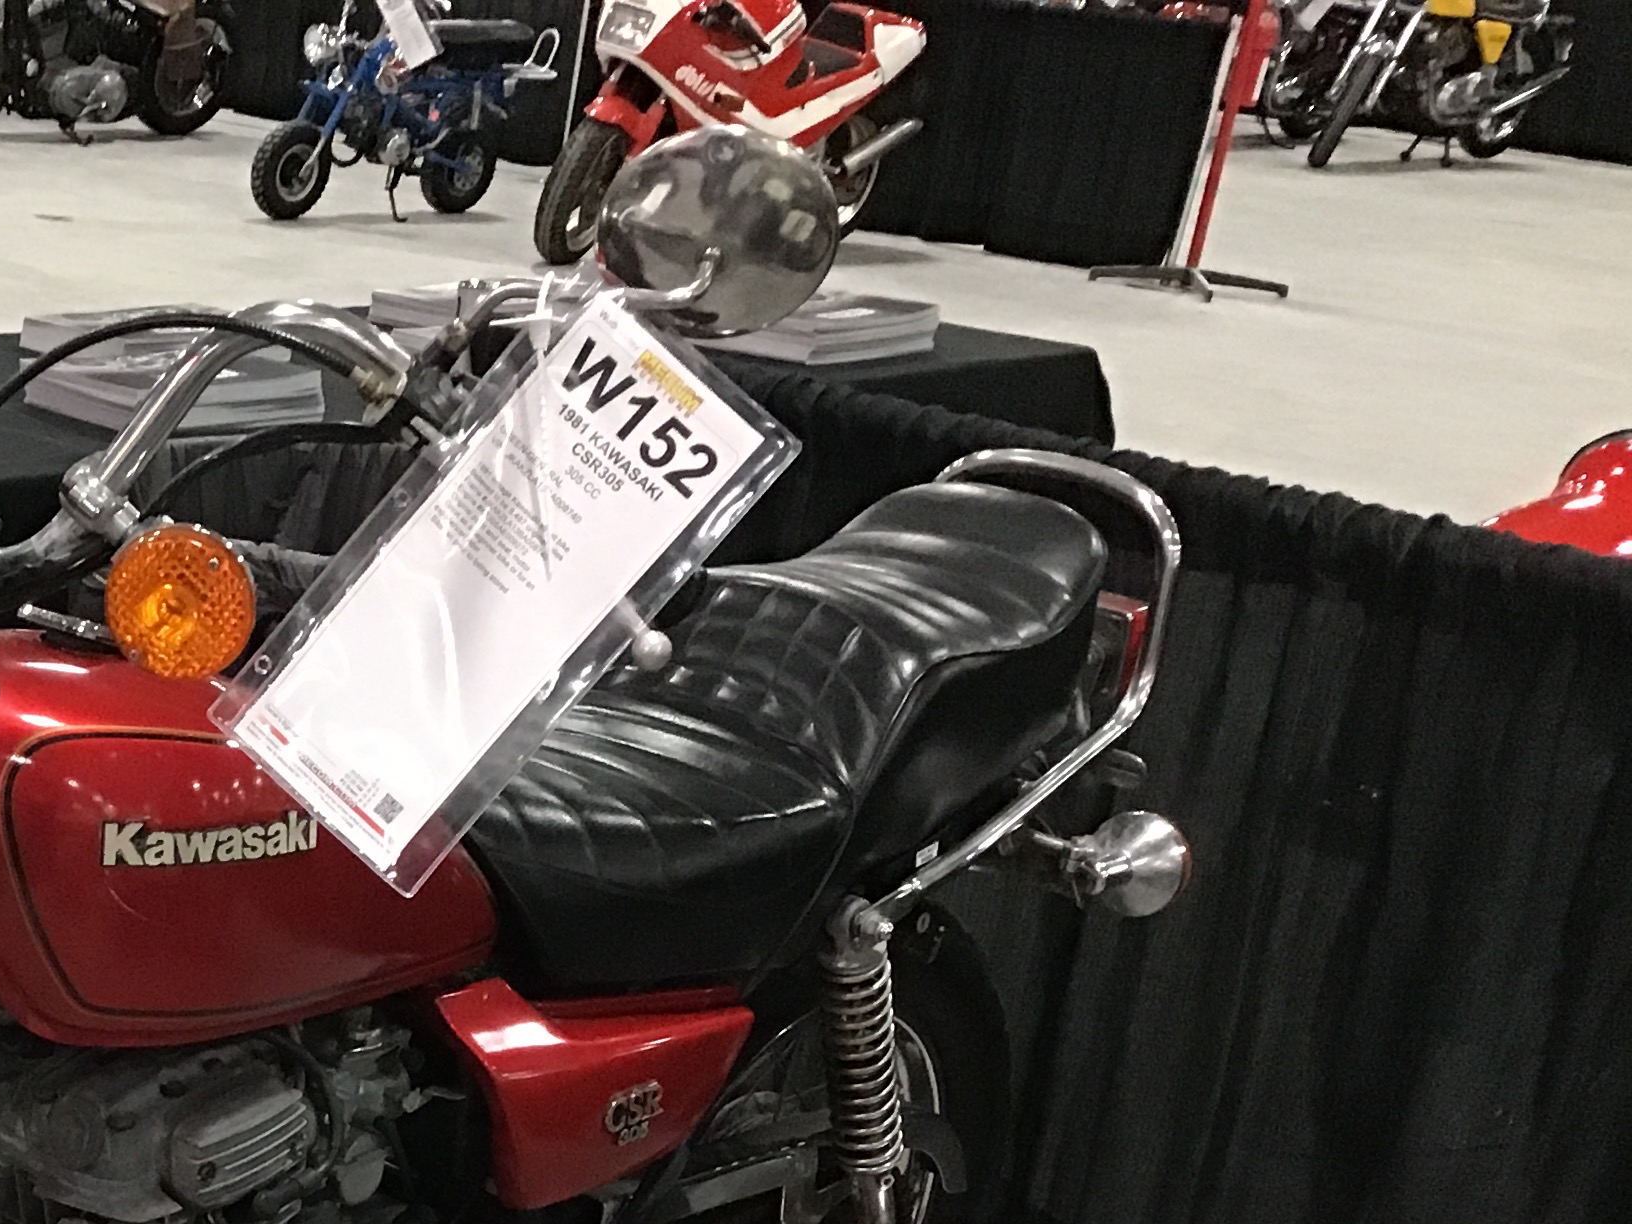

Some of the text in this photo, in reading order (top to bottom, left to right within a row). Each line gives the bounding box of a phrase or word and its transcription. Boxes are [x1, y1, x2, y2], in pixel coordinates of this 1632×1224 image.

[561, 337, 716, 500] W152
[557, 402, 664, 502] 1981 KAWASAKI
[569, 441, 624, 492] CSR305
[563, 464, 601, 500] 305 CC
[103, 810, 317, 866] Kawasaki
[606, 1080, 664, 1133] CSR
